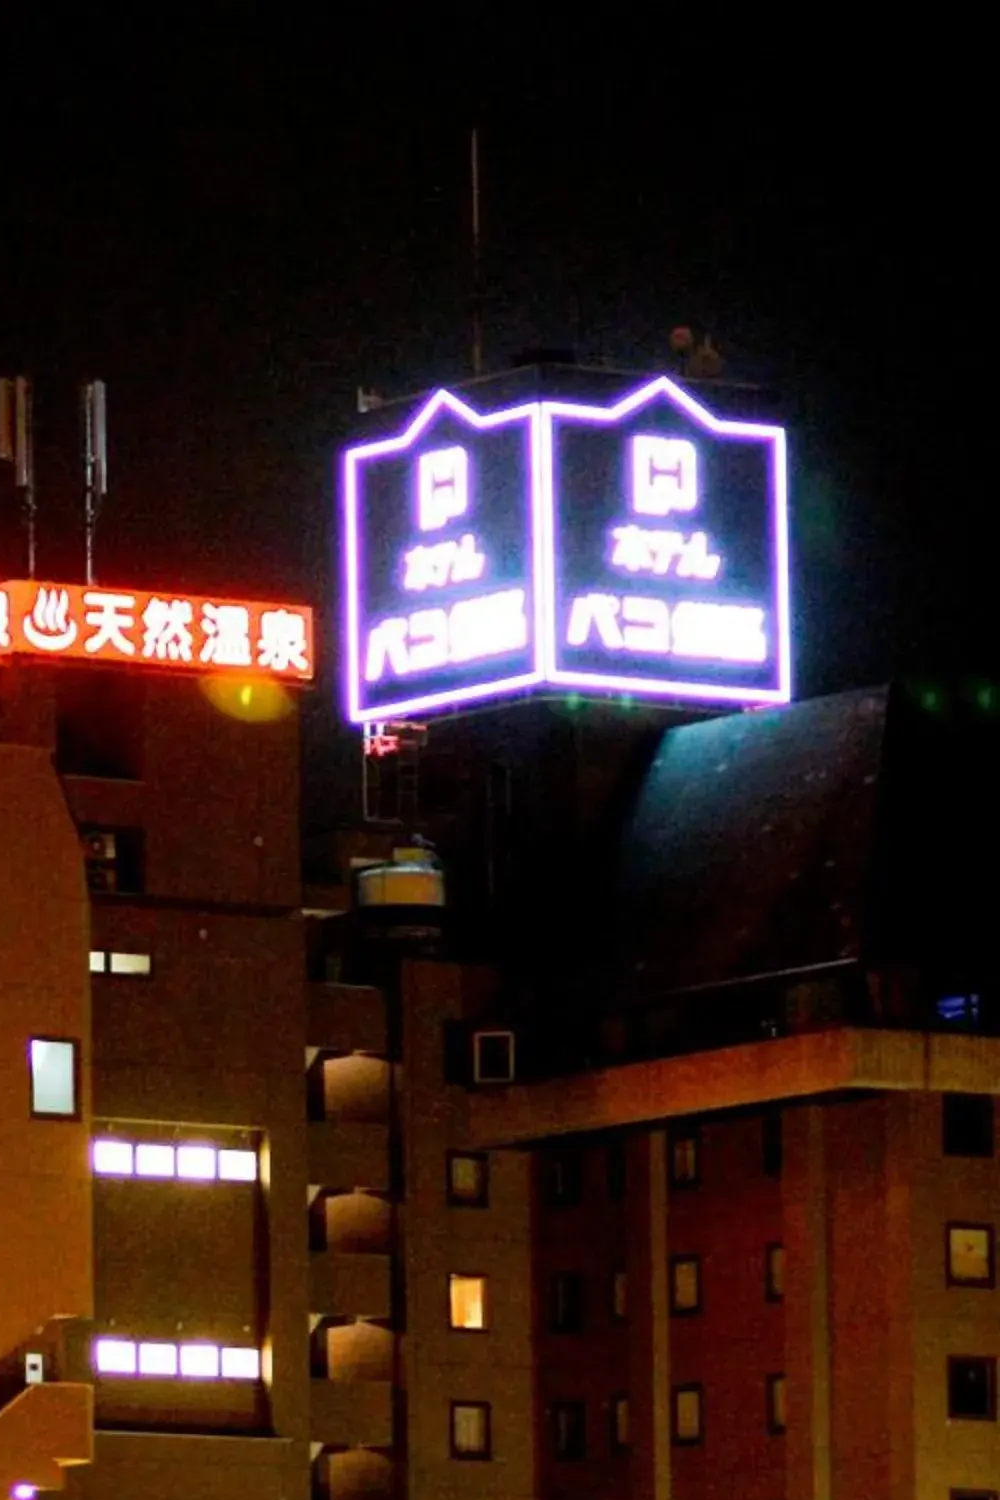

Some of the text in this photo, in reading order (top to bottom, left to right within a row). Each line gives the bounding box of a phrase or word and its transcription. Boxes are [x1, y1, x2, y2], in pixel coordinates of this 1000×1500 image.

[82, 590, 309, 671] 天然温泉
[365, 587, 528, 683] パコ
[566, 592, 768, 664] パコ
